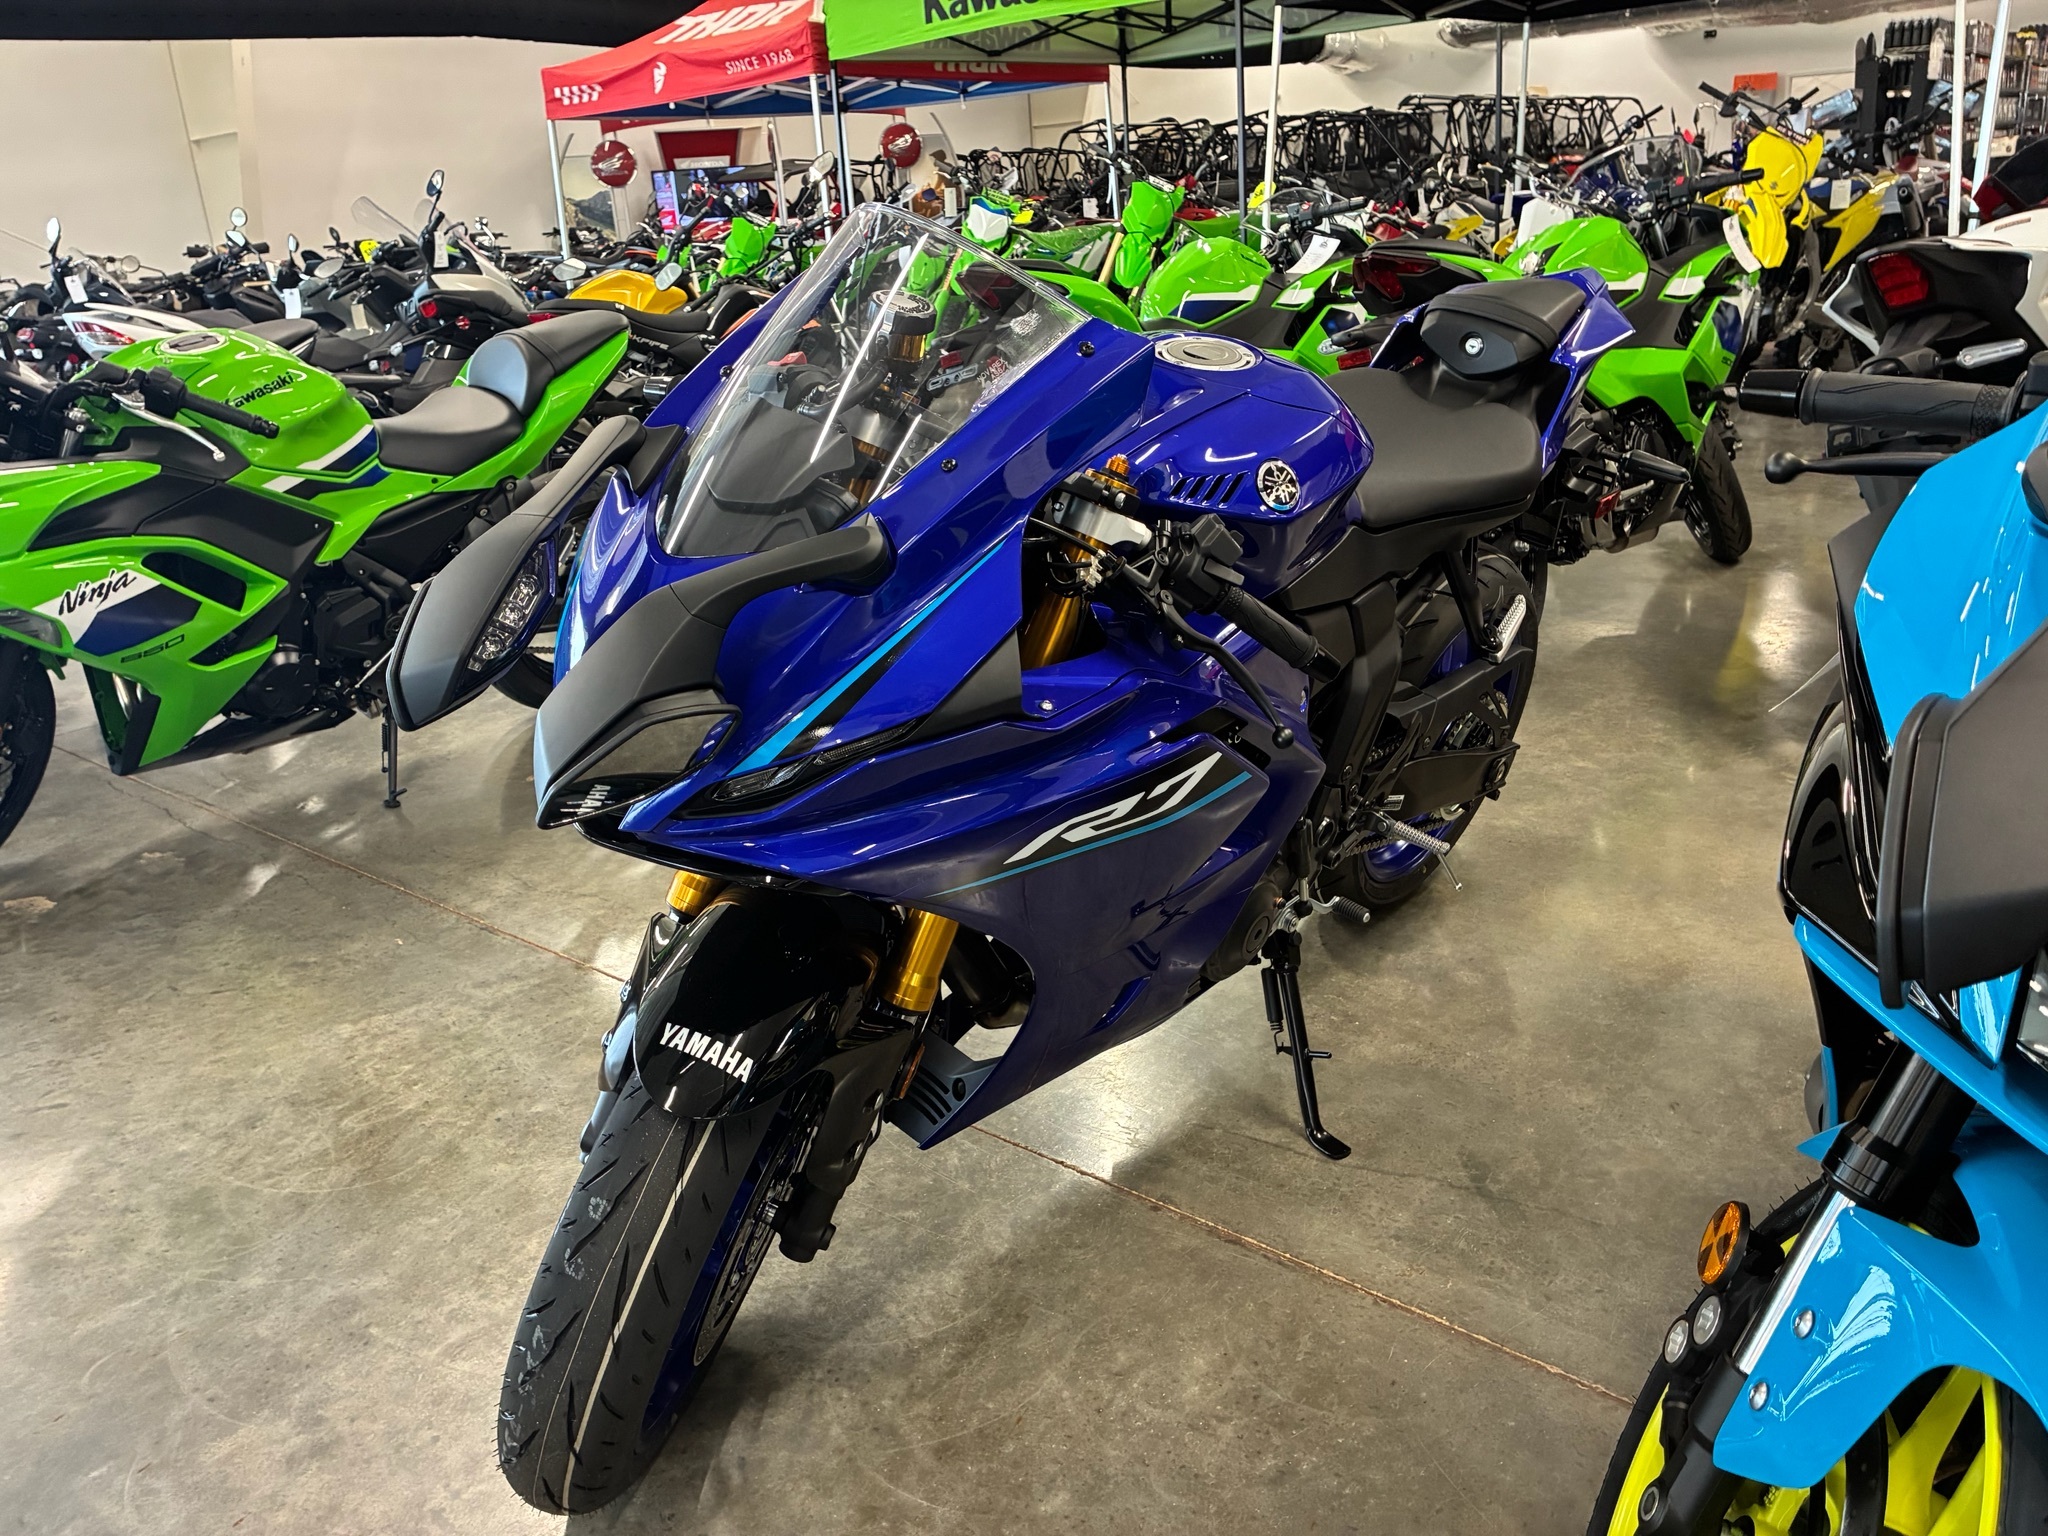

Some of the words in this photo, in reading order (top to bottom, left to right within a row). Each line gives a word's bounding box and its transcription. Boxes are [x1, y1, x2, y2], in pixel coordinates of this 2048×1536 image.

[653, 0, 810, 44] THOR
[725, 58, 761, 75] SINCE
[763, 48, 795, 67] 1968
[58, 569, 137, 616] Ninja
[1003, 752, 1223, 865] R7
[659, 1022, 754, 1084] YAMAHA
